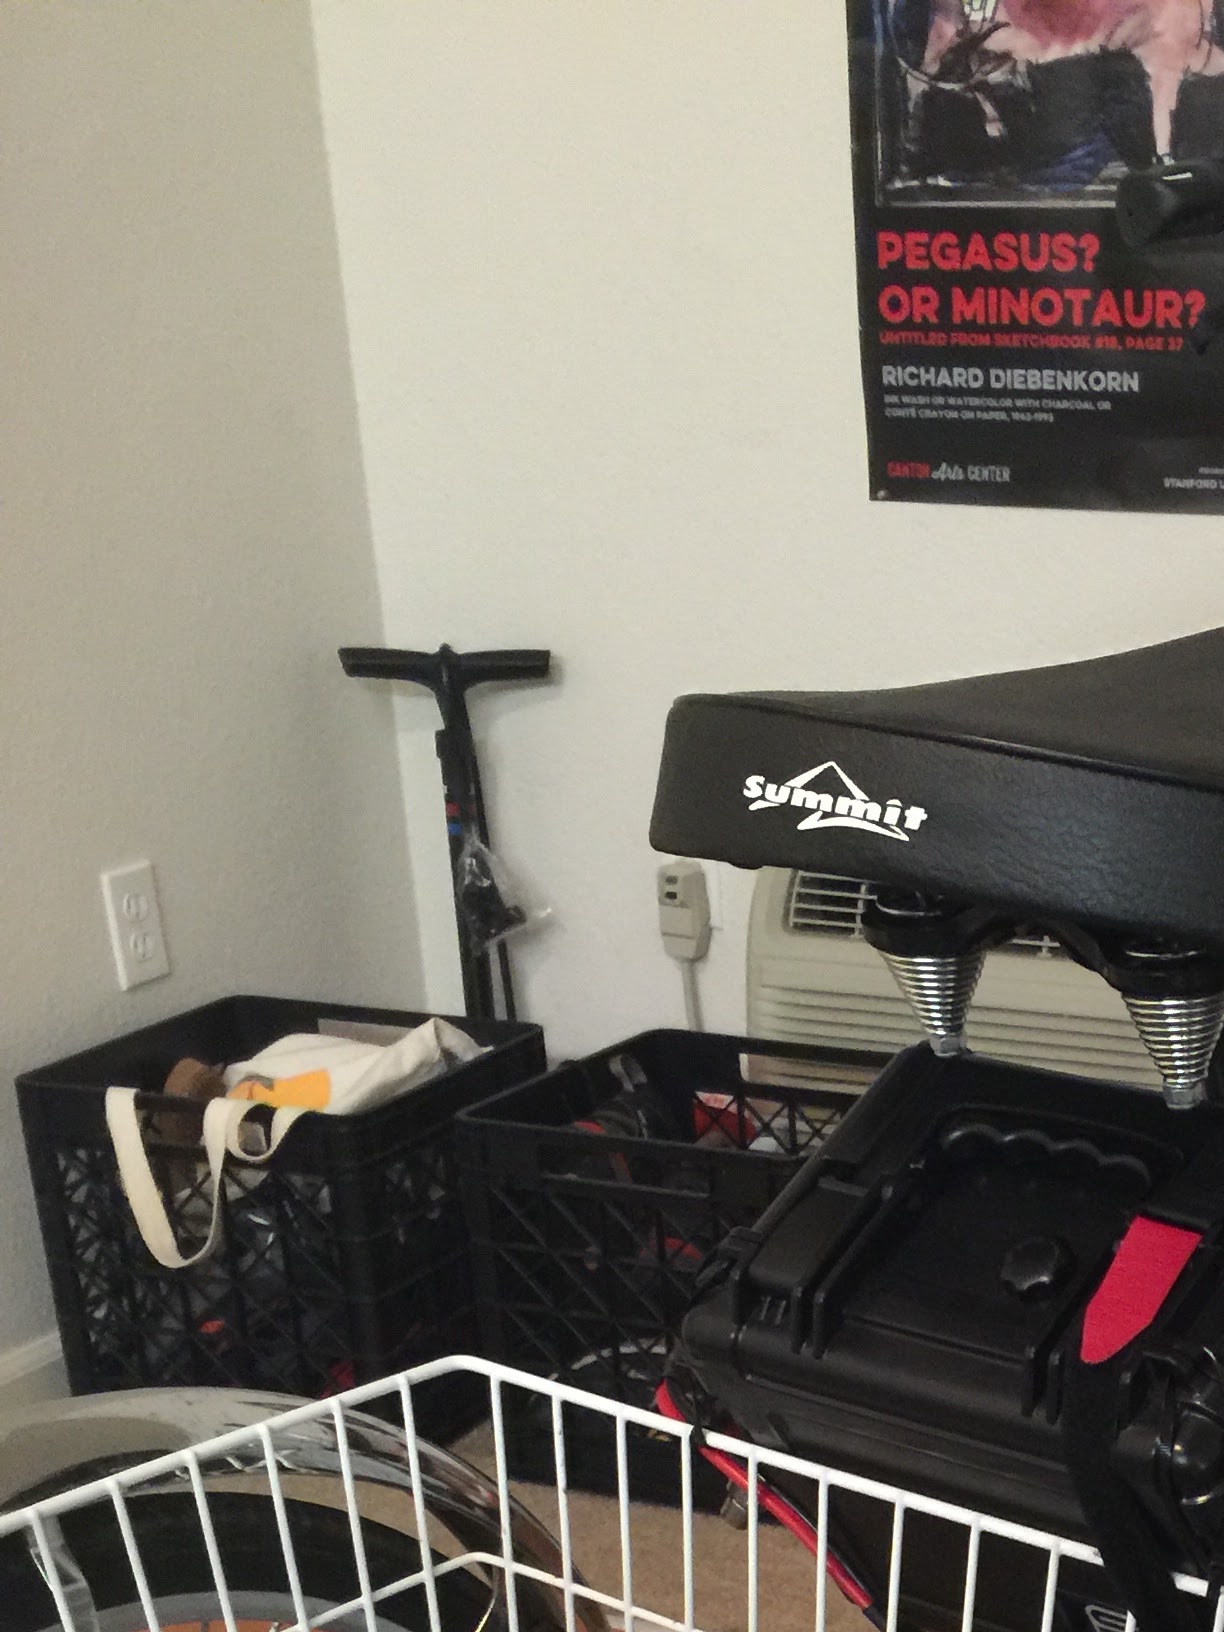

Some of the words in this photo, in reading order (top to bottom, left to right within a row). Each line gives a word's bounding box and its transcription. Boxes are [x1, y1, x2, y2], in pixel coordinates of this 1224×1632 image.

[877, 230, 1100, 272] PEGASUS?
[879, 285, 938, 324] OR
[952, 286, 1206, 329] MINOTAUR?
[880, 330, 947, 346] UNTITLED
[951, 332, 990, 346] FROM
[995, 333, 1090, 348] SKETCHBOOK
[1125, 336, 1164, 350] PAGE
[882, 365, 983, 388] RICHARD
[989, 368, 1139, 392] DIEBENKORN
[967, 465, 1010, 482] CENTER
[1163, 477, 1217, 489] STANFORD
